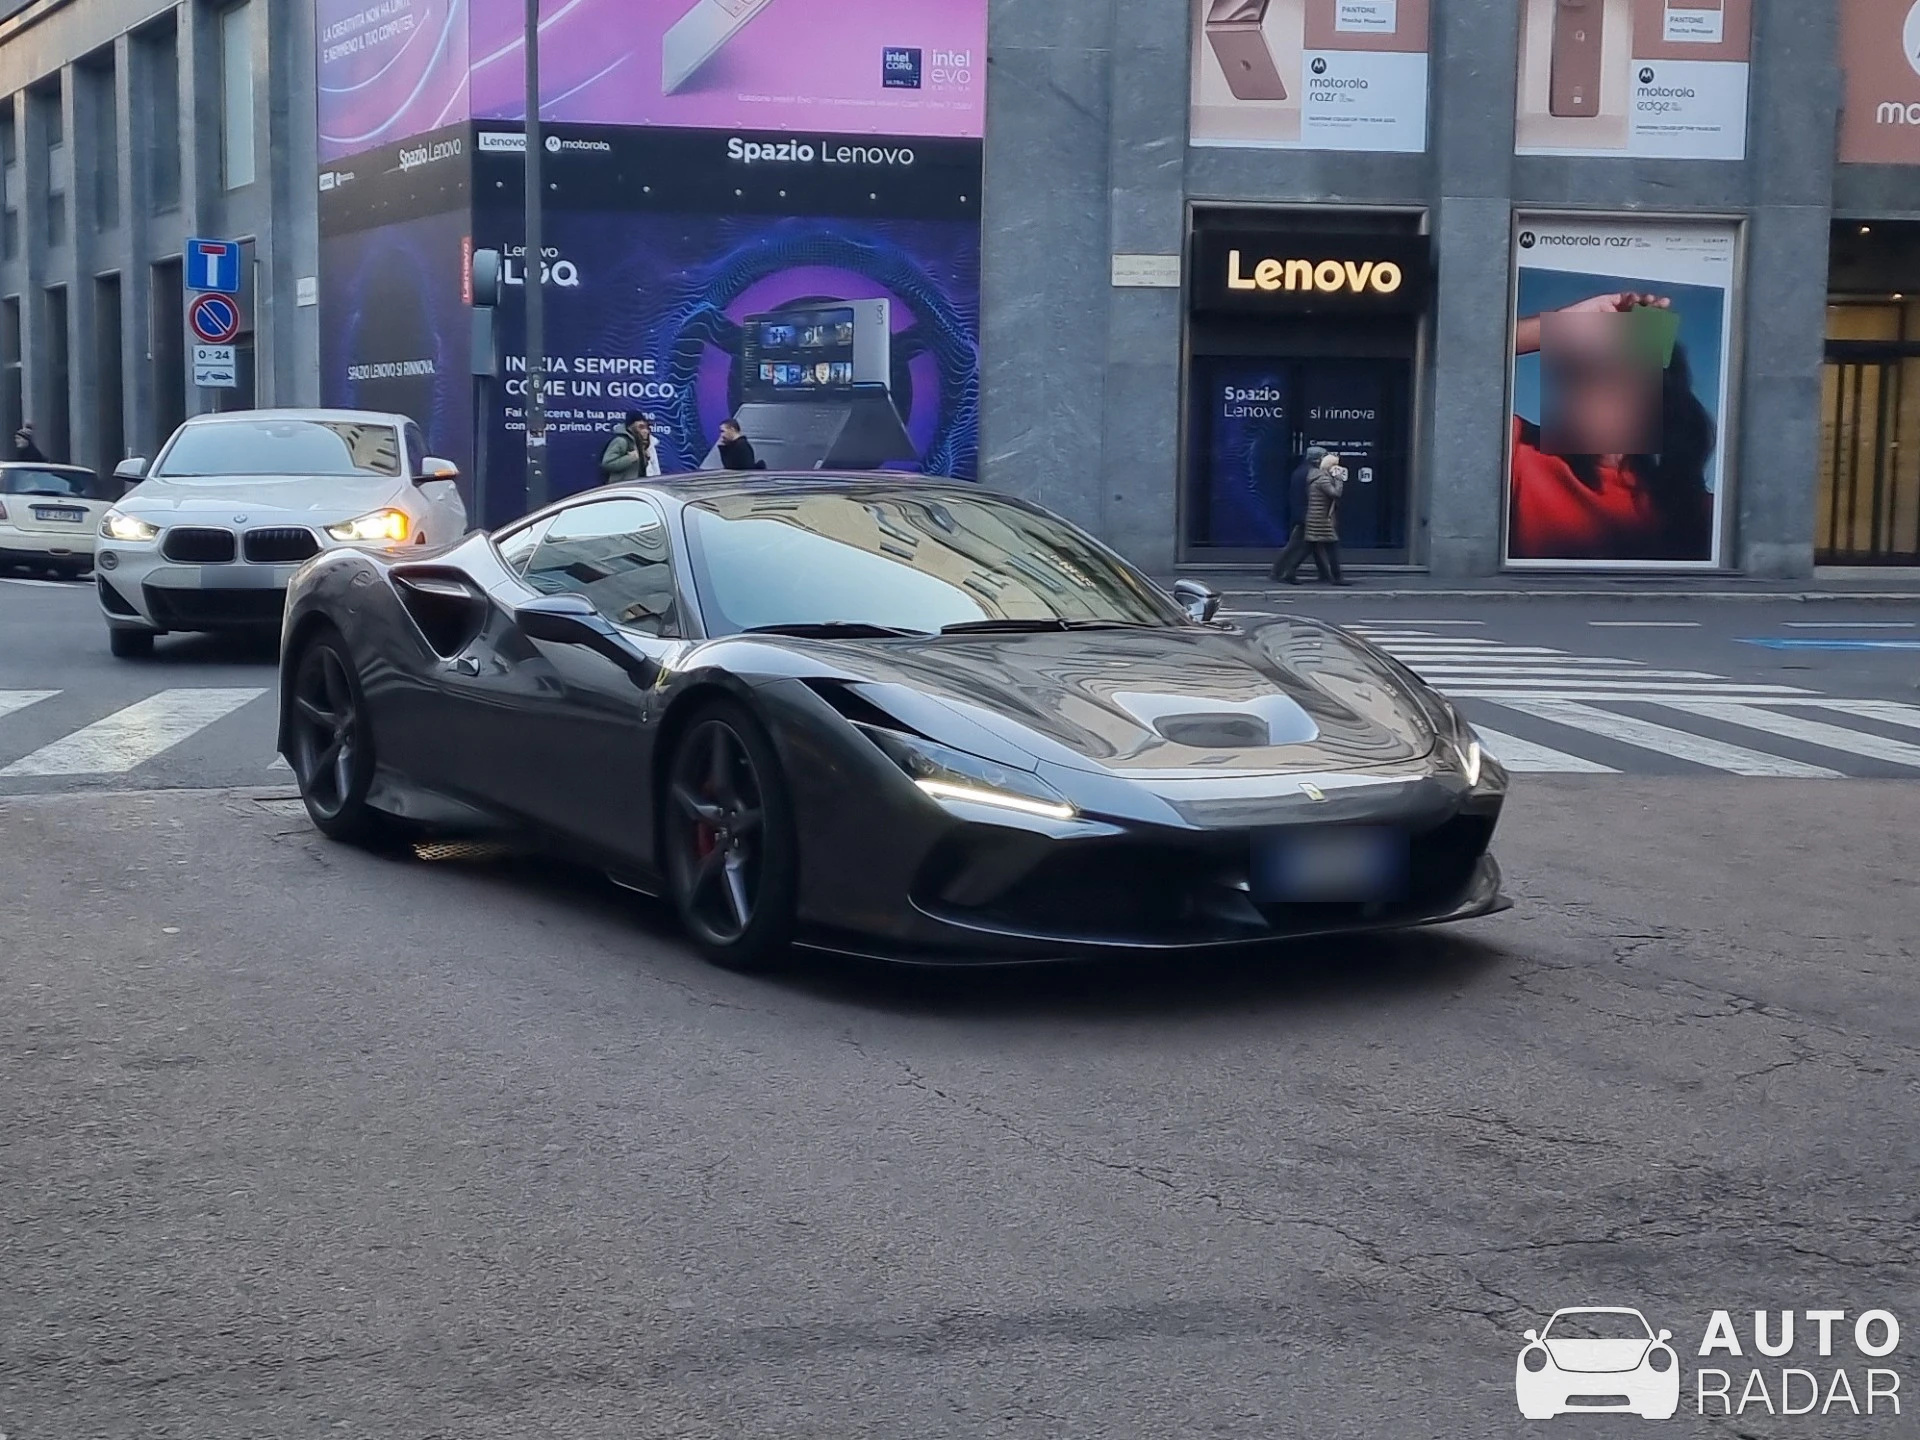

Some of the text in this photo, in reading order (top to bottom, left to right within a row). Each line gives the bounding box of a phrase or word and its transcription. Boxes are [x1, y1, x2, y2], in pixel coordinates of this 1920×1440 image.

[1341, 6, 1377, 14] PANTONE
[1669, 16, 1705, 24] PANTONE
[886, 51, 909, 62] intel
[932, 49, 970, 67] intel
[931, 69, 971, 84] evo
[1309, 77, 1369, 89] motorola
[1309, 91, 1338, 102] razr
[1637, 87, 1696, 98] motorola
[1636, 100, 1671, 116] edge
[483, 136, 526, 147] Lenovo
[562, 139, 611, 151] motorola
[399, 138, 462, 172] Spazio Lenovo
[727, 137, 914, 165] Spazio Lenovo
[1539, 235, 1601, 247] motorola
[1604, 235, 1634, 247] razr
[504, 243, 559, 258] Lenvo
[1227, 250, 1402, 293] Lenovo
[505, 356, 656, 375] INIA SEMPRE
[571, 381, 602, 398] UN
[606, 382, 680, 399] GIOCO.
[1224, 386, 1281, 403] Spazio
[505, 408, 522, 418] Fai
[573, 408, 584, 419] la
[587, 409, 605, 420] tua
[607, 410, 656, 421] pasne
[1324, 407, 1376, 420] rinnova
[505, 422, 526, 432] con
[559, 421, 593, 434] primo
[595, 423, 611, 433] PC
